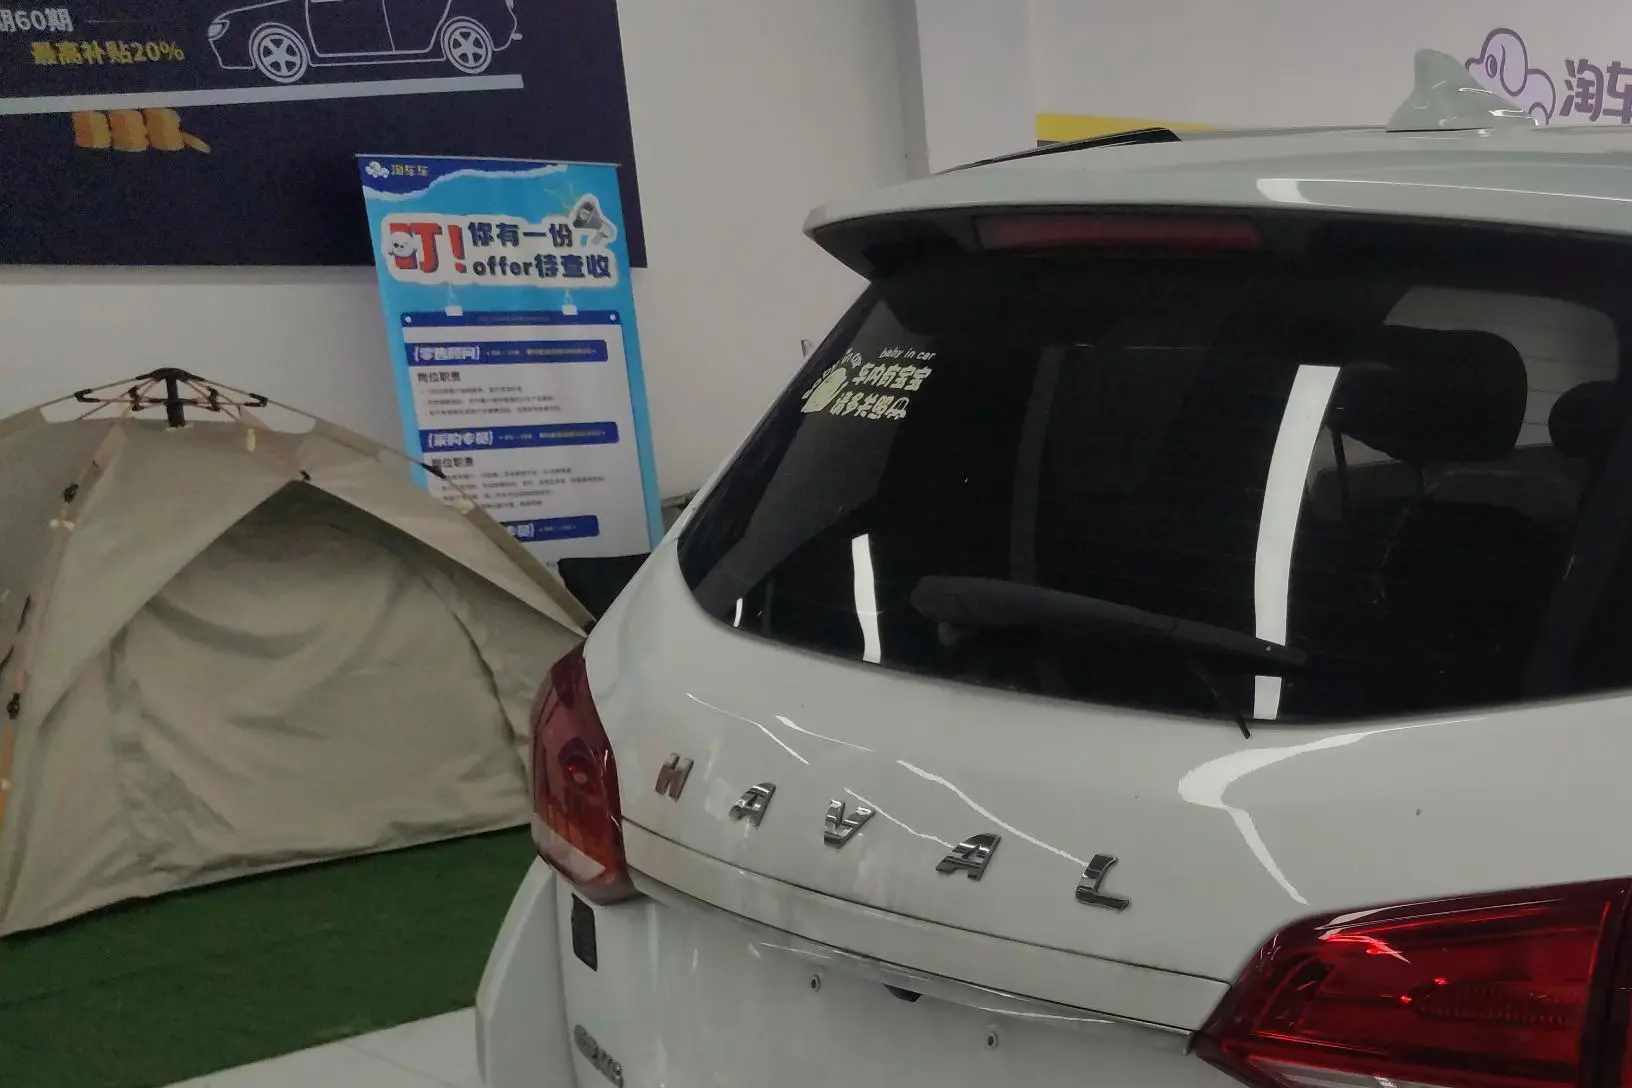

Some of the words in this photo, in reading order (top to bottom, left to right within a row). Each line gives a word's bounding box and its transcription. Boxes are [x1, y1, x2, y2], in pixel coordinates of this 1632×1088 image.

[467, 221, 574, 249] 你有一份
[472, 253, 612, 279] offer待查收
[878, 346, 903, 359] baby
[904, 347, 915, 359] in
[916, 350, 937, 361] car
[851, 362, 933, 392] 车内有宝宝
[654, 751, 1130, 912] HAVAL
